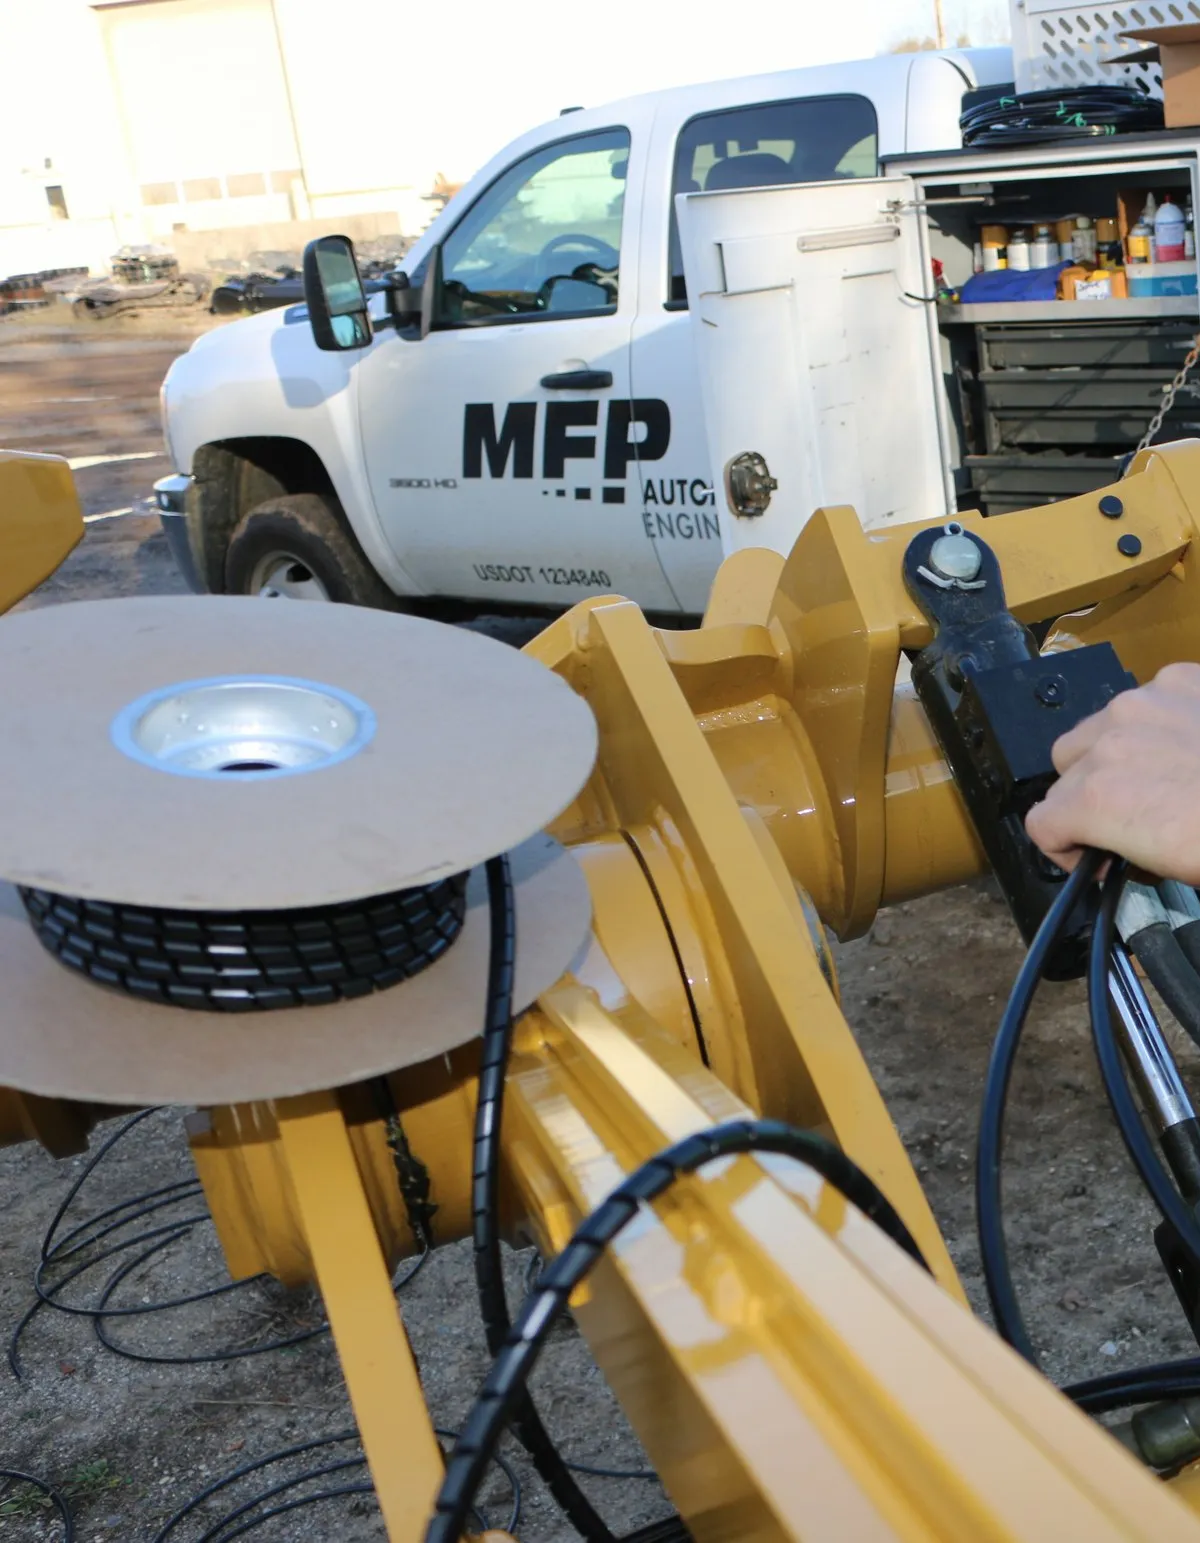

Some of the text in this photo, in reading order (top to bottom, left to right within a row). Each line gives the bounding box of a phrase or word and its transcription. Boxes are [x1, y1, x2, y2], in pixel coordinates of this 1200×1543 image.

[462, 398, 671, 479] MFP
[643, 478, 716, 506] AUTO
[472, 564, 612, 588] USDOT 1234840
